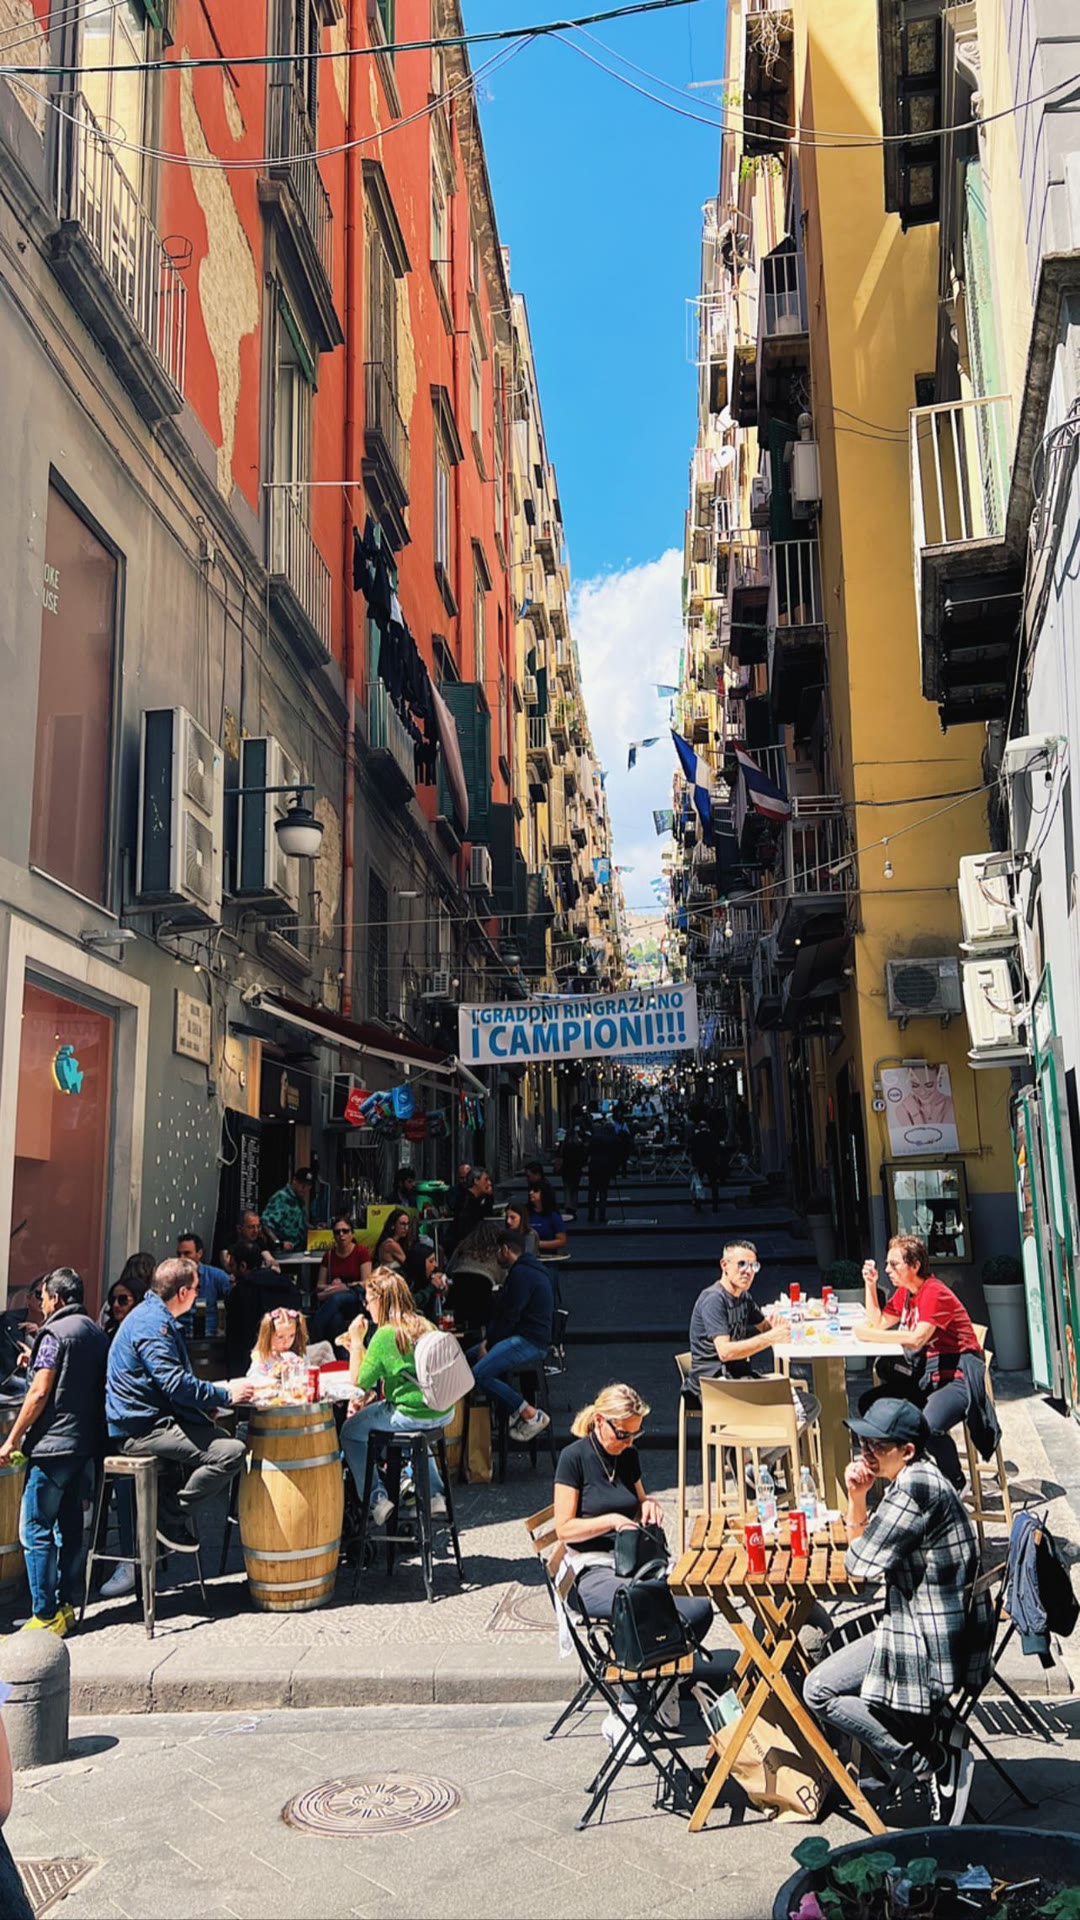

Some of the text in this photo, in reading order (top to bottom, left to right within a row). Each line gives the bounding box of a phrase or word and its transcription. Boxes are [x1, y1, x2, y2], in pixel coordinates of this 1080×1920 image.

[471, 992, 683, 1025] I GRADONI RINGRAZIANO
[471, 1011, 687, 1059] I CAMPIONI!!!
